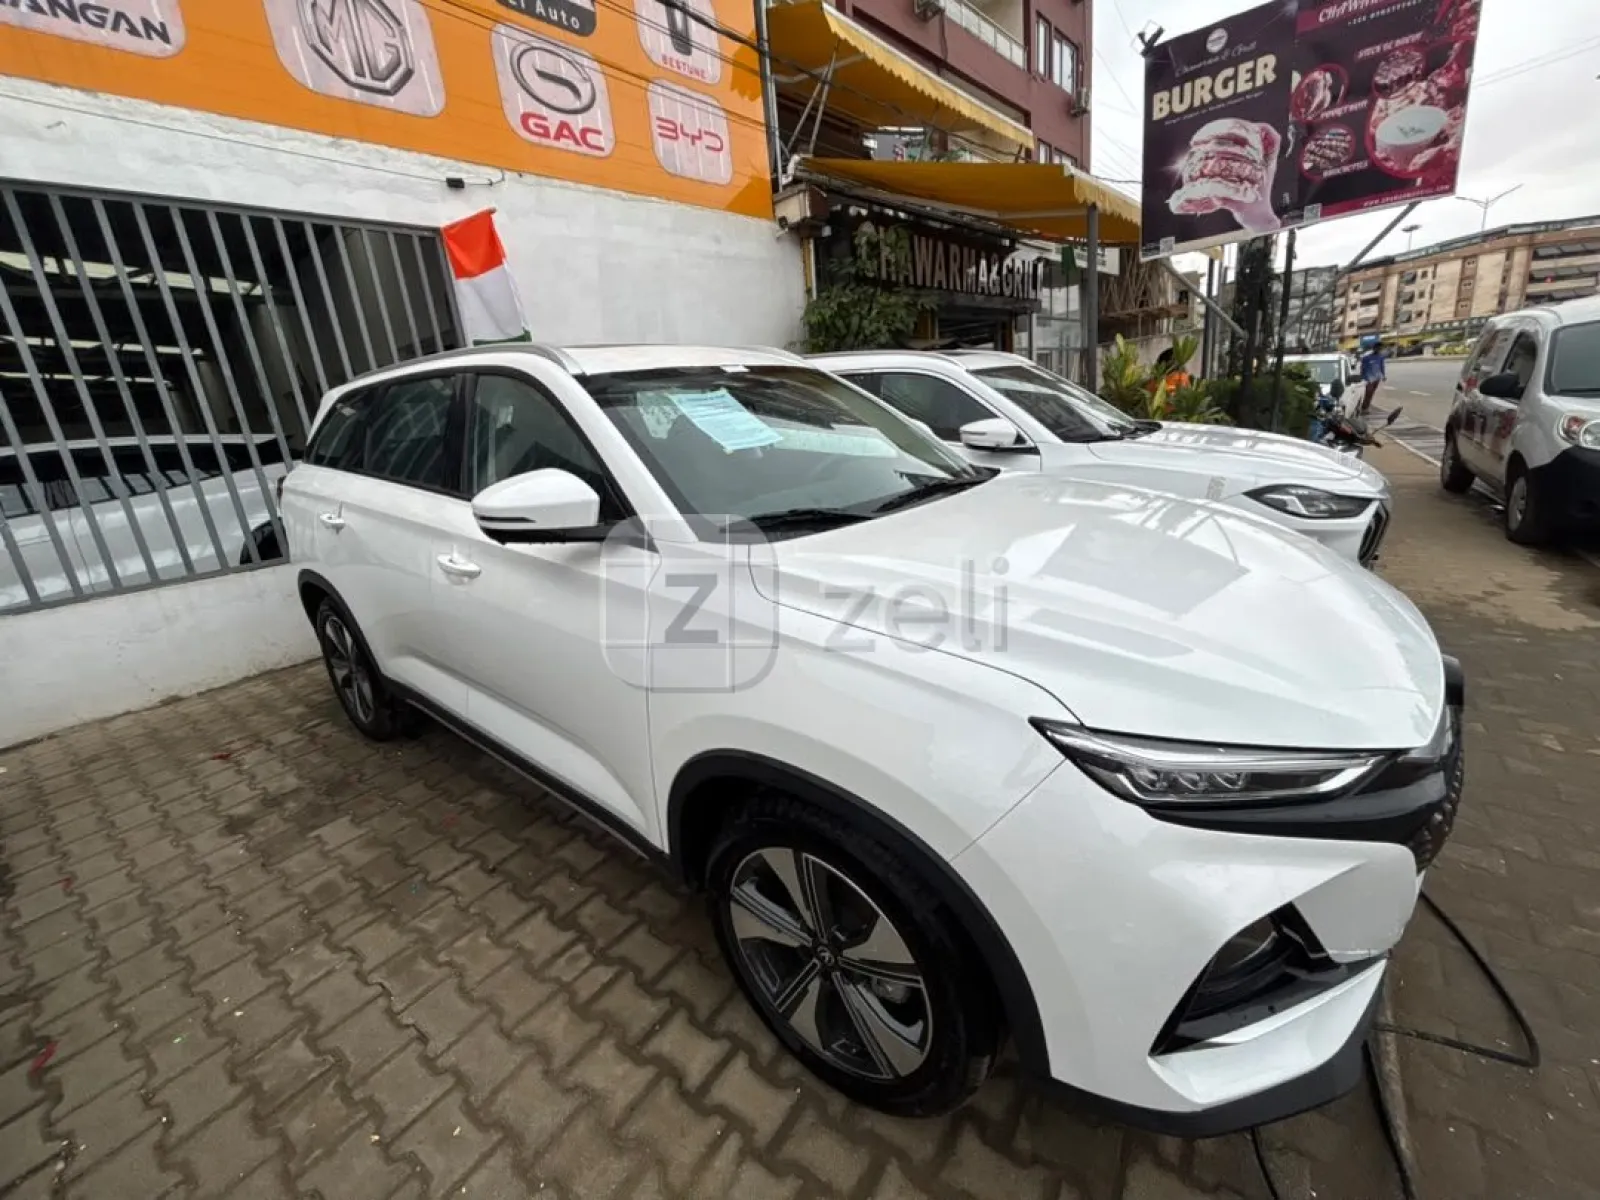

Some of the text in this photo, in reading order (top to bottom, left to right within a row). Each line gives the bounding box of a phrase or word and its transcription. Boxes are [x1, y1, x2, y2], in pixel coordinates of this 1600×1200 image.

[0, 0, 172, 45] ANGAN
[535, 0, 581, 29] Auto
[1152, 54, 1277, 121] BURGER
[519, 111, 605, 151] GAC
[656, 116, 724, 151] BYD
